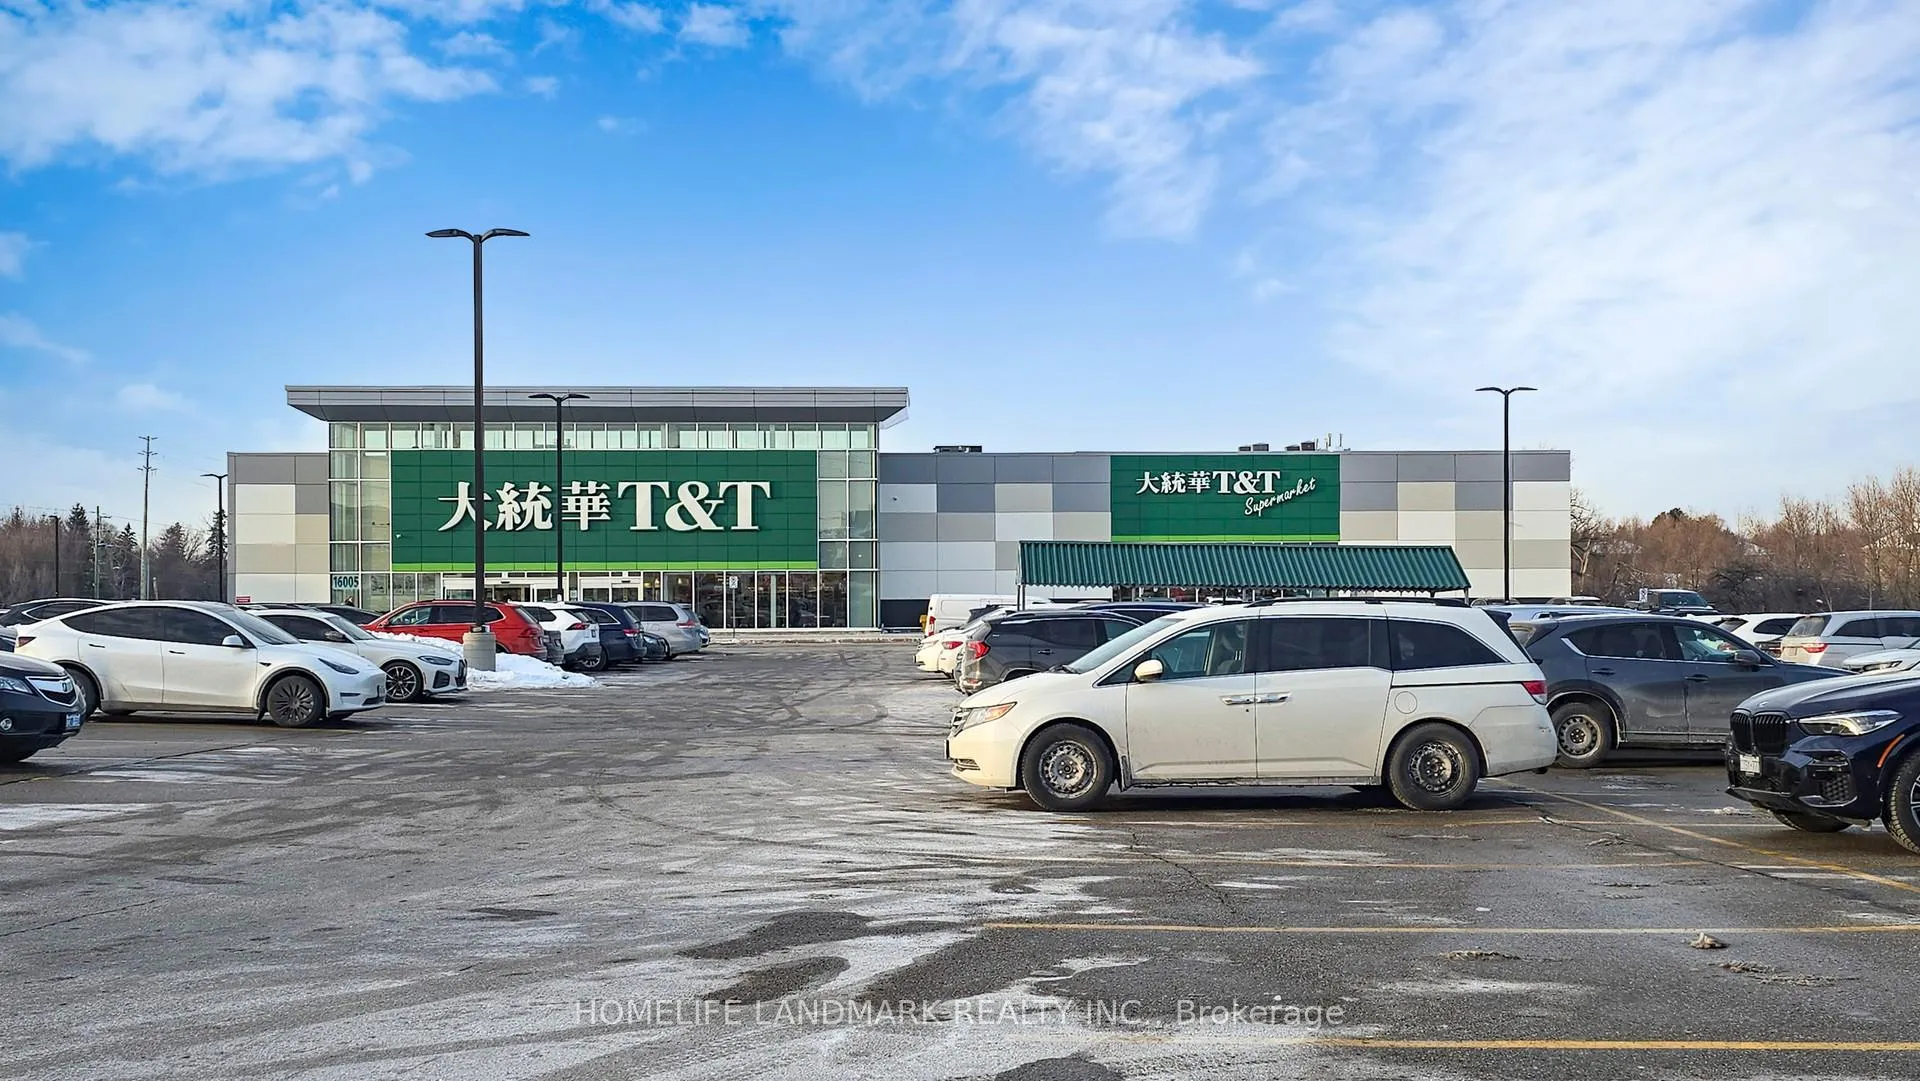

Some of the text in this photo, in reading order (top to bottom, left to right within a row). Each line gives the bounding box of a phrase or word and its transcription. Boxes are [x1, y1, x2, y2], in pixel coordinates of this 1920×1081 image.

[1135, 471, 1281, 495] 大統華 T&T
[1244, 477, 1316, 517] Supermarket
[438, 481, 771, 531] 大統華 T&T
[333, 576, 359, 588] 16005
